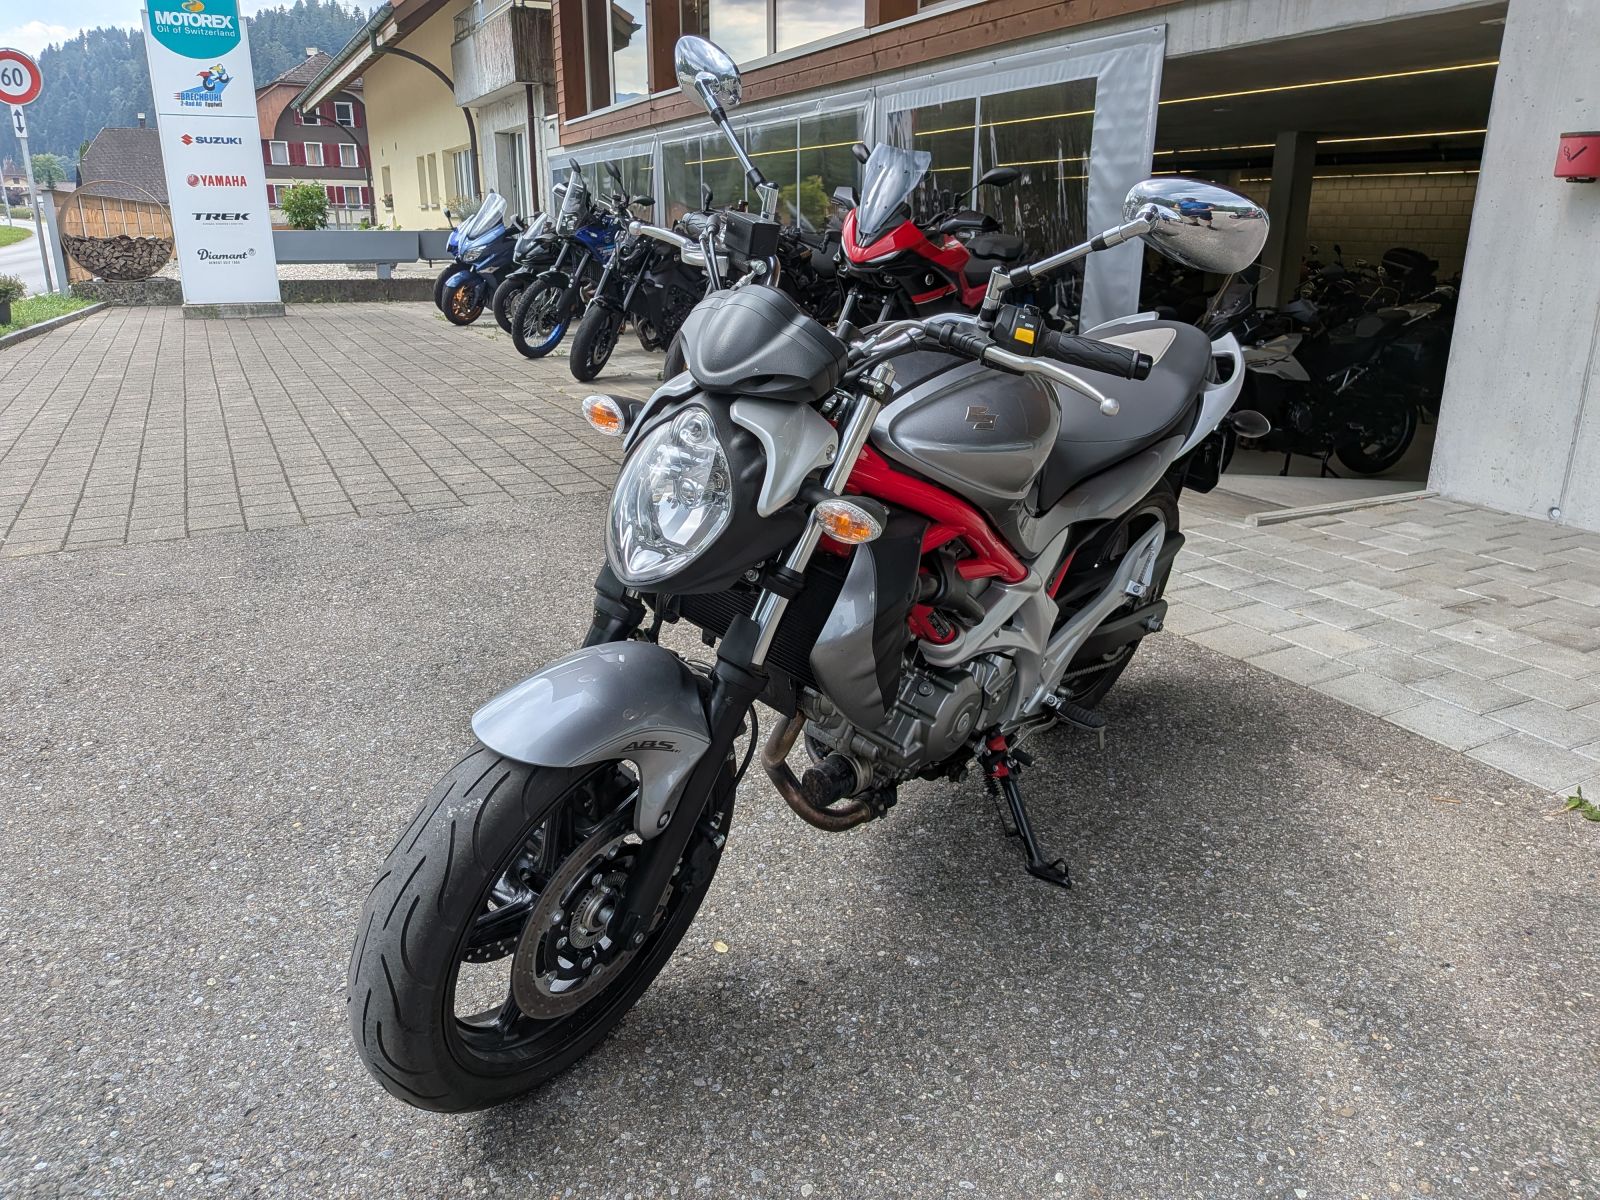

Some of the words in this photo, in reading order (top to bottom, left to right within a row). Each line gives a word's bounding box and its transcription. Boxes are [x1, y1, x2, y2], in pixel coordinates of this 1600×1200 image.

[154, 10, 233, 29] MOTOREX
[156, 25, 170, 33] Oil
[172, 25, 181, 34] of
[184, 27, 235, 37] Switzerland
[1, 67, 23, 87] 60
[195, 136, 242, 145] SUZUKI
[200, 175, 247, 187] YAMAHA
[192, 212, 251, 221] TREK
[197, 248, 248, 261] Diamant
[621, 740, 677, 751] ABS
